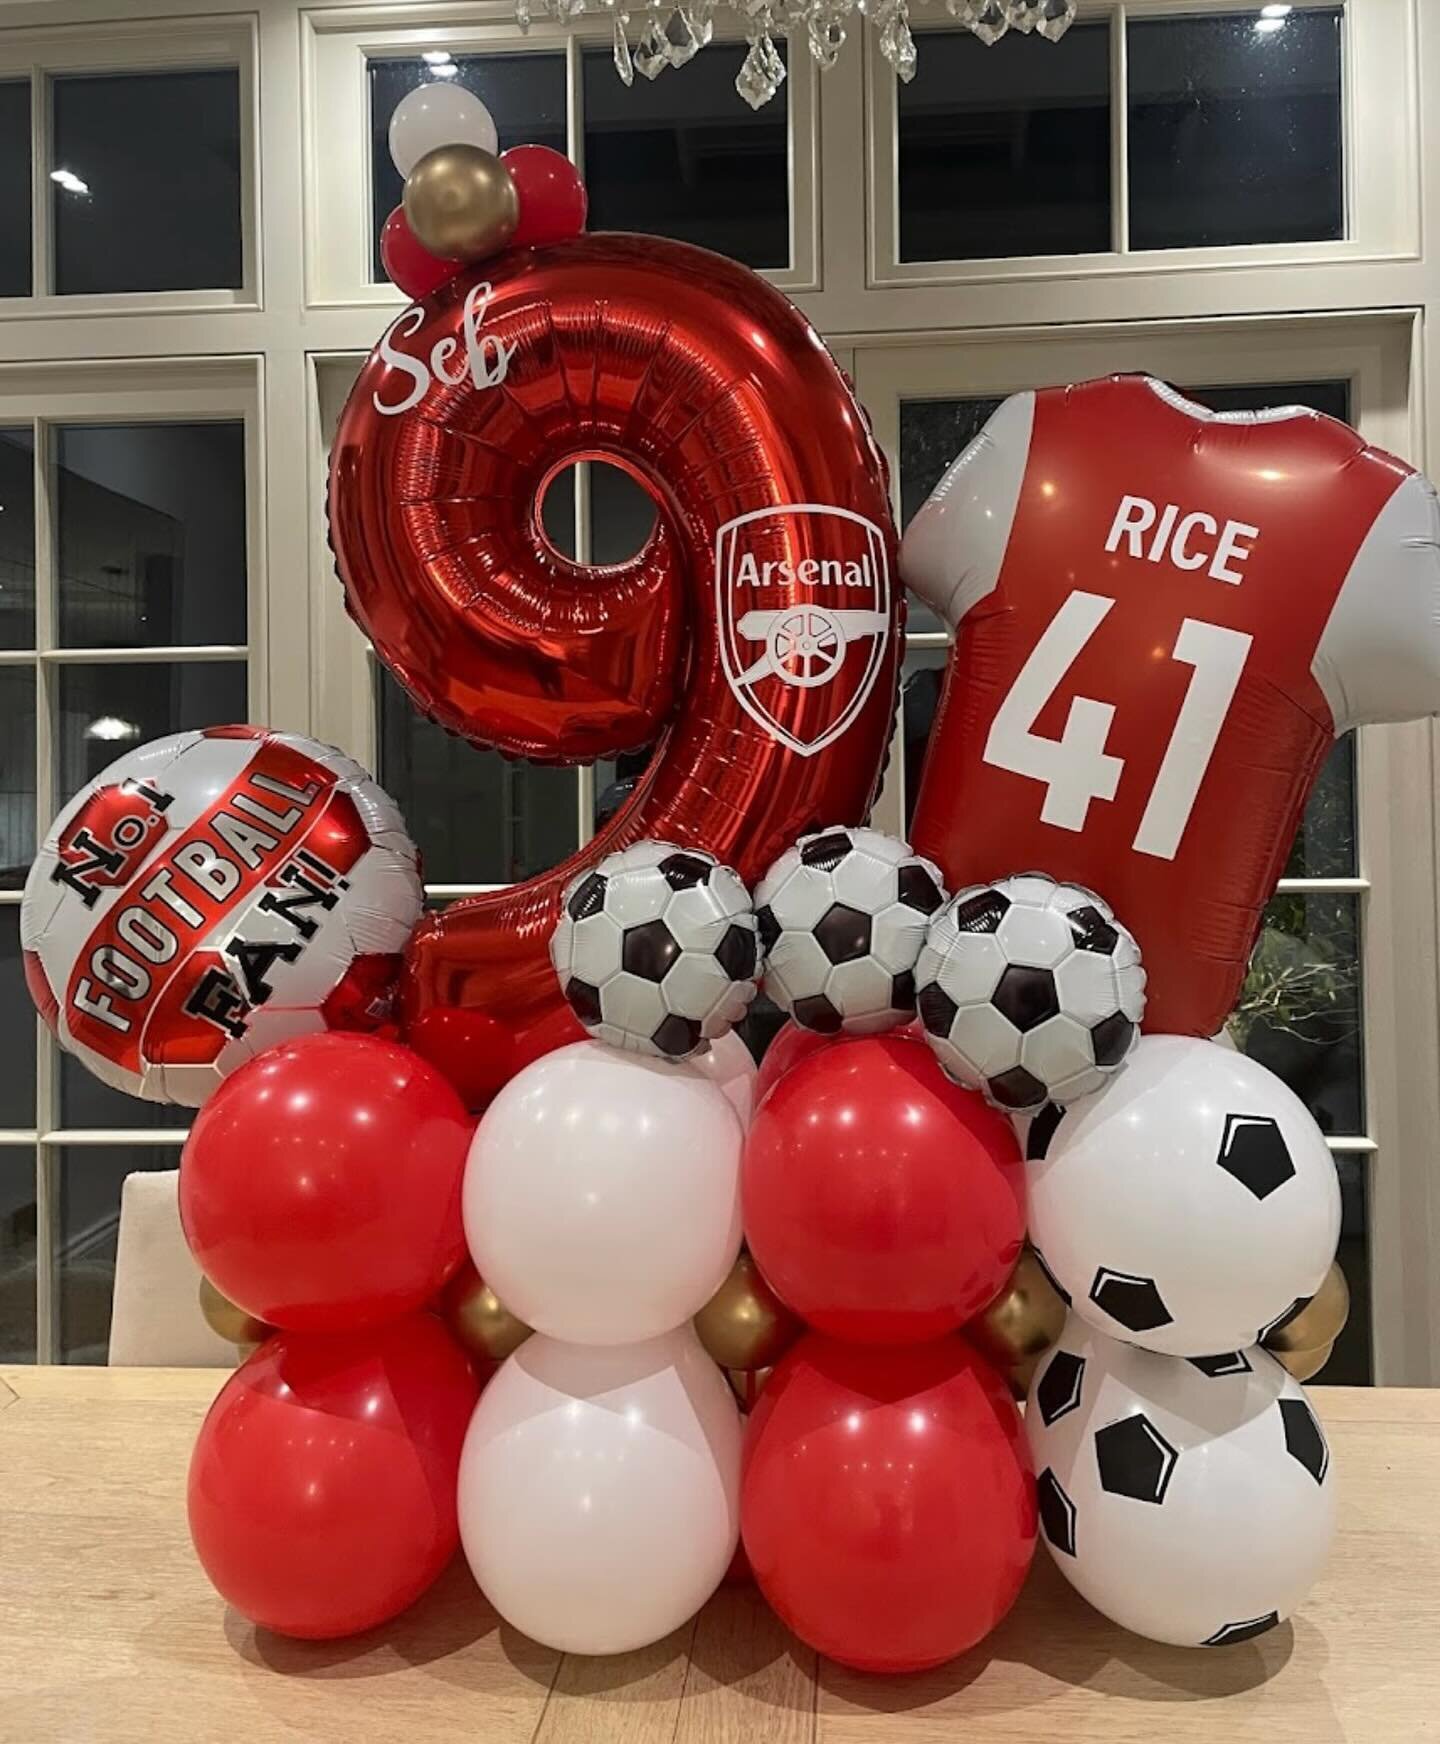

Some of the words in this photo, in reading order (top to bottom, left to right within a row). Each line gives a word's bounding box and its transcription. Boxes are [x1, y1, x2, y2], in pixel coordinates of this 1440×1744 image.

[373, 282, 518, 415] Seb
[736, 552, 872, 587] Arsenal
[1104, 495, 1259, 586] RICE
[982, 589, 1254, 861] 41
[73, 773, 320, 1033] FOOTBALL
[182, 850, 350, 1041] FAN!
